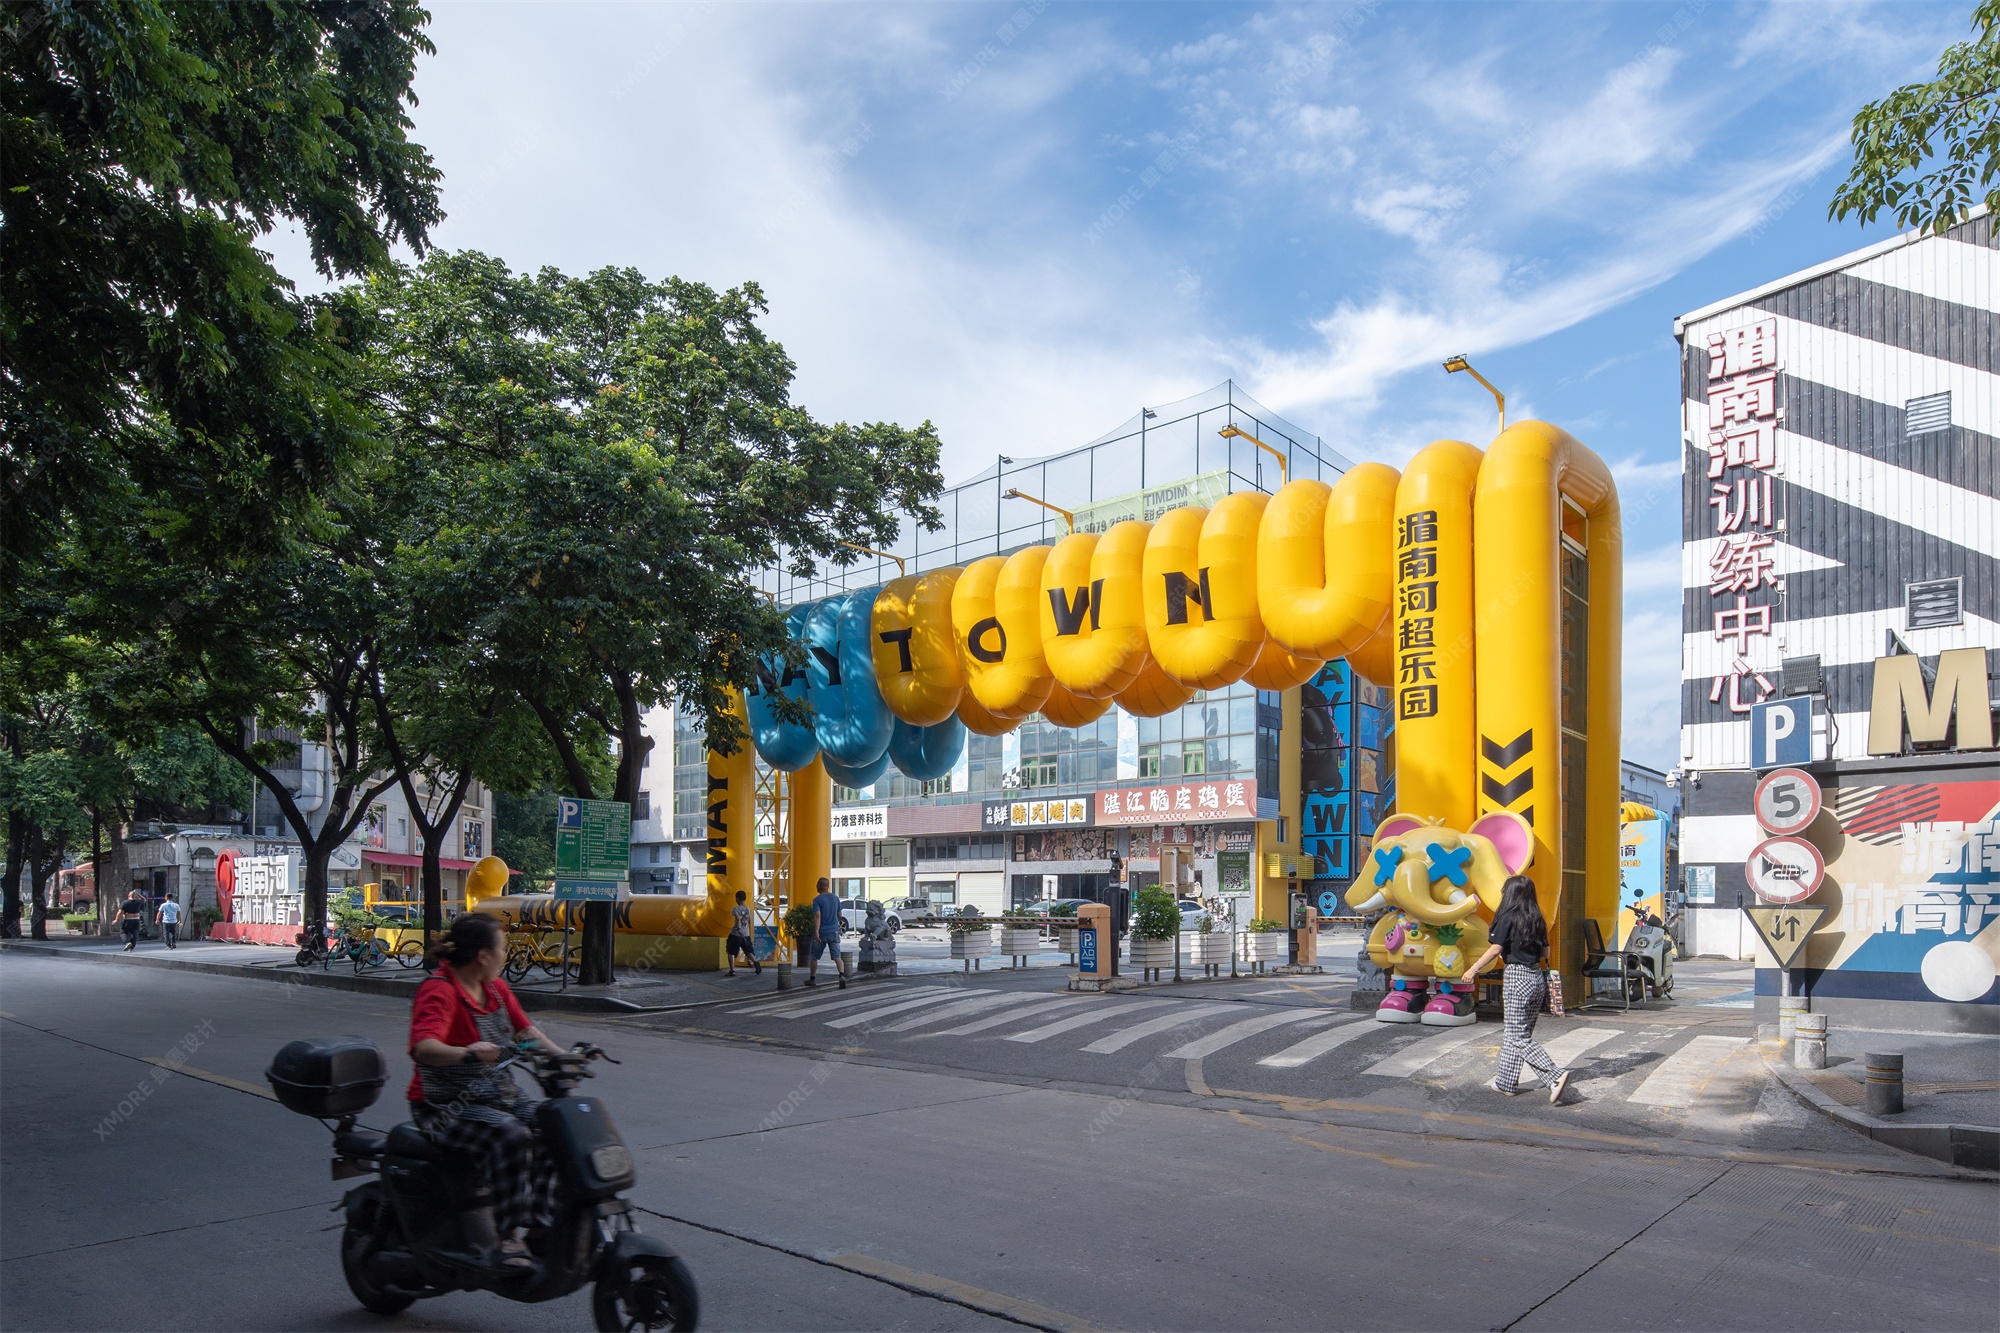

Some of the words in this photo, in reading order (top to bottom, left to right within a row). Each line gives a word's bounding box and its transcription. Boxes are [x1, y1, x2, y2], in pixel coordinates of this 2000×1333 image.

[1144, 485, 1188, 507] TIMDIM
[1707, 317, 1777, 712] 湄南河训练中心
[879, 566, 1216, 674] TOWN
[1397, 510, 1440, 721] 湄南河超乐园
[1867, 646, 1994, 756] M
[1765, 704, 1796, 764] P
[562, 801, 579, 823] P
[1103, 783, 1246, 815] 湛江脆皮鸡煲
[1772, 782, 1801, 818] 5
[831, 812, 883, 828] 力德营养科技
[1082, 949, 1095, 957] 入口
[1084, 933, 1092, 947] P
